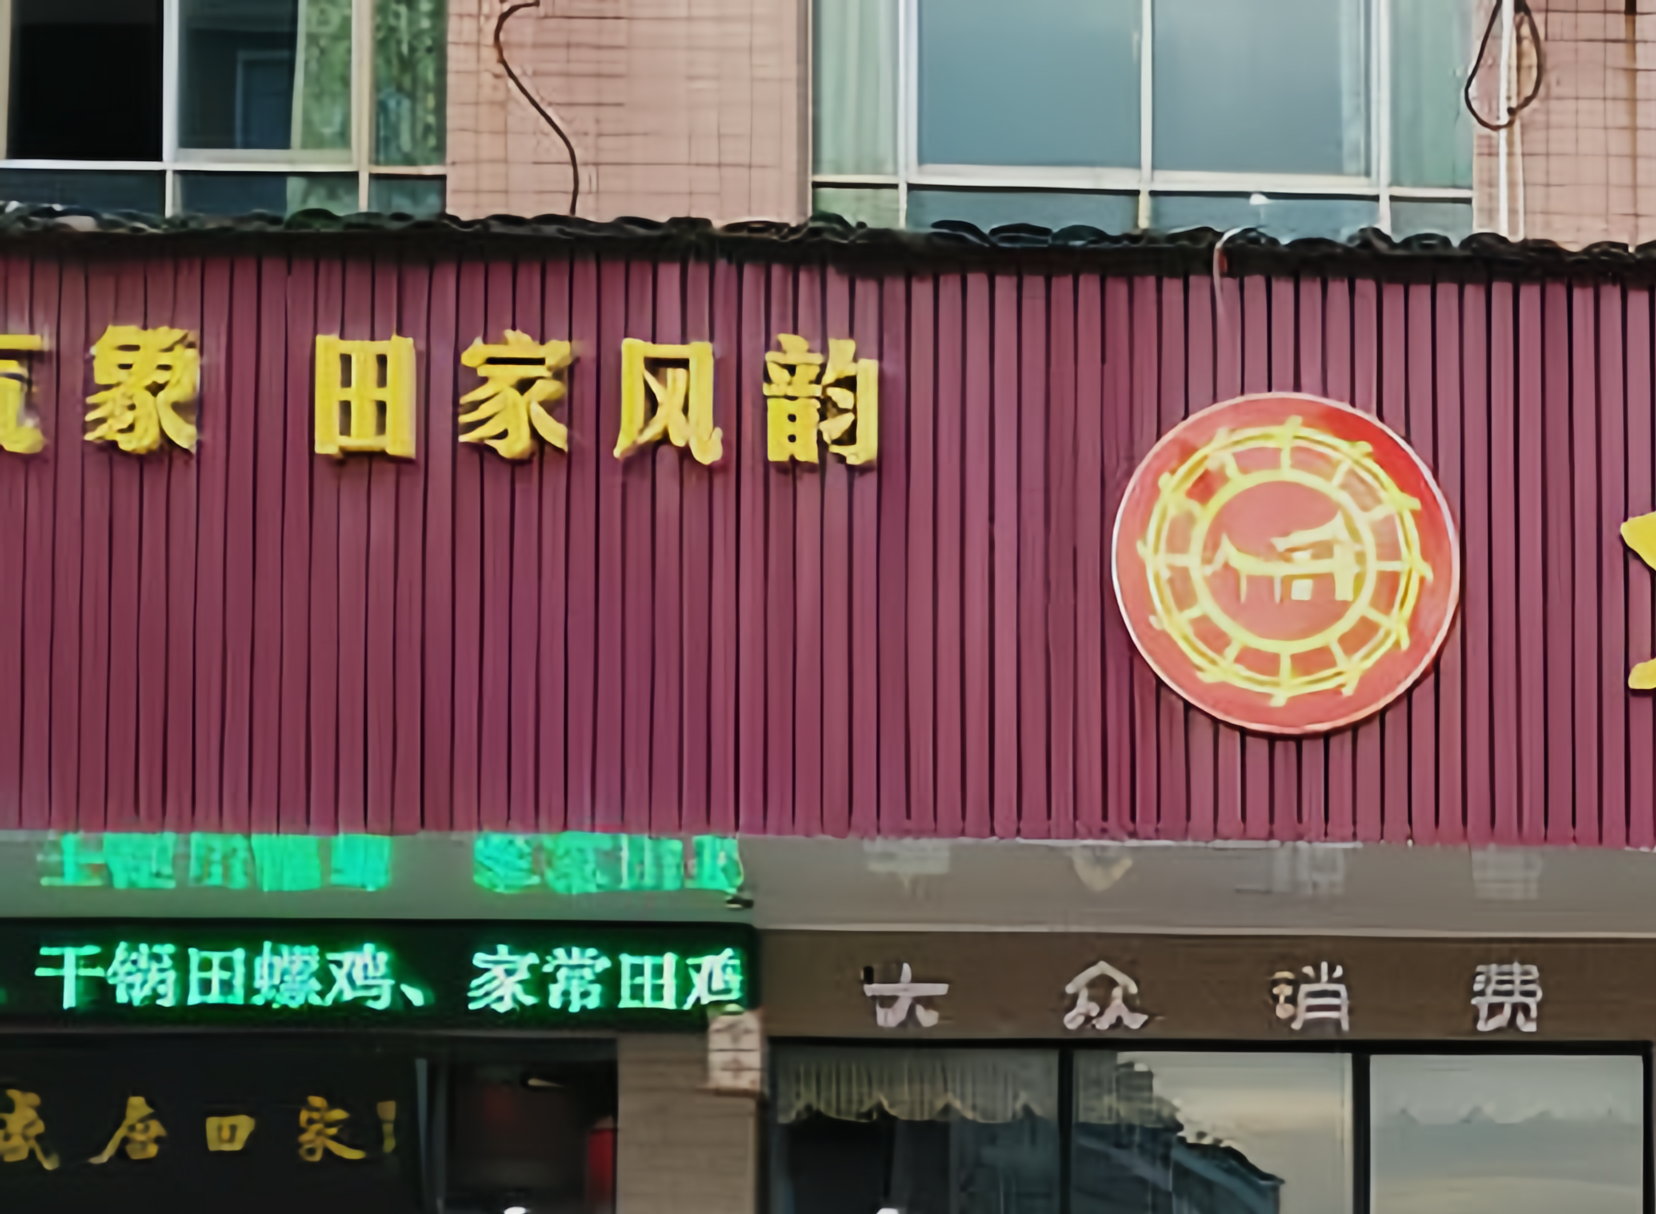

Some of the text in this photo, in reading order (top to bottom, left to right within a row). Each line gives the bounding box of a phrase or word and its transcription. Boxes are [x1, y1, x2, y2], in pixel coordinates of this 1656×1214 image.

[313, 330, 880, 466] 田家风韵
[862, 960, 1543, 1033] 大众消费
